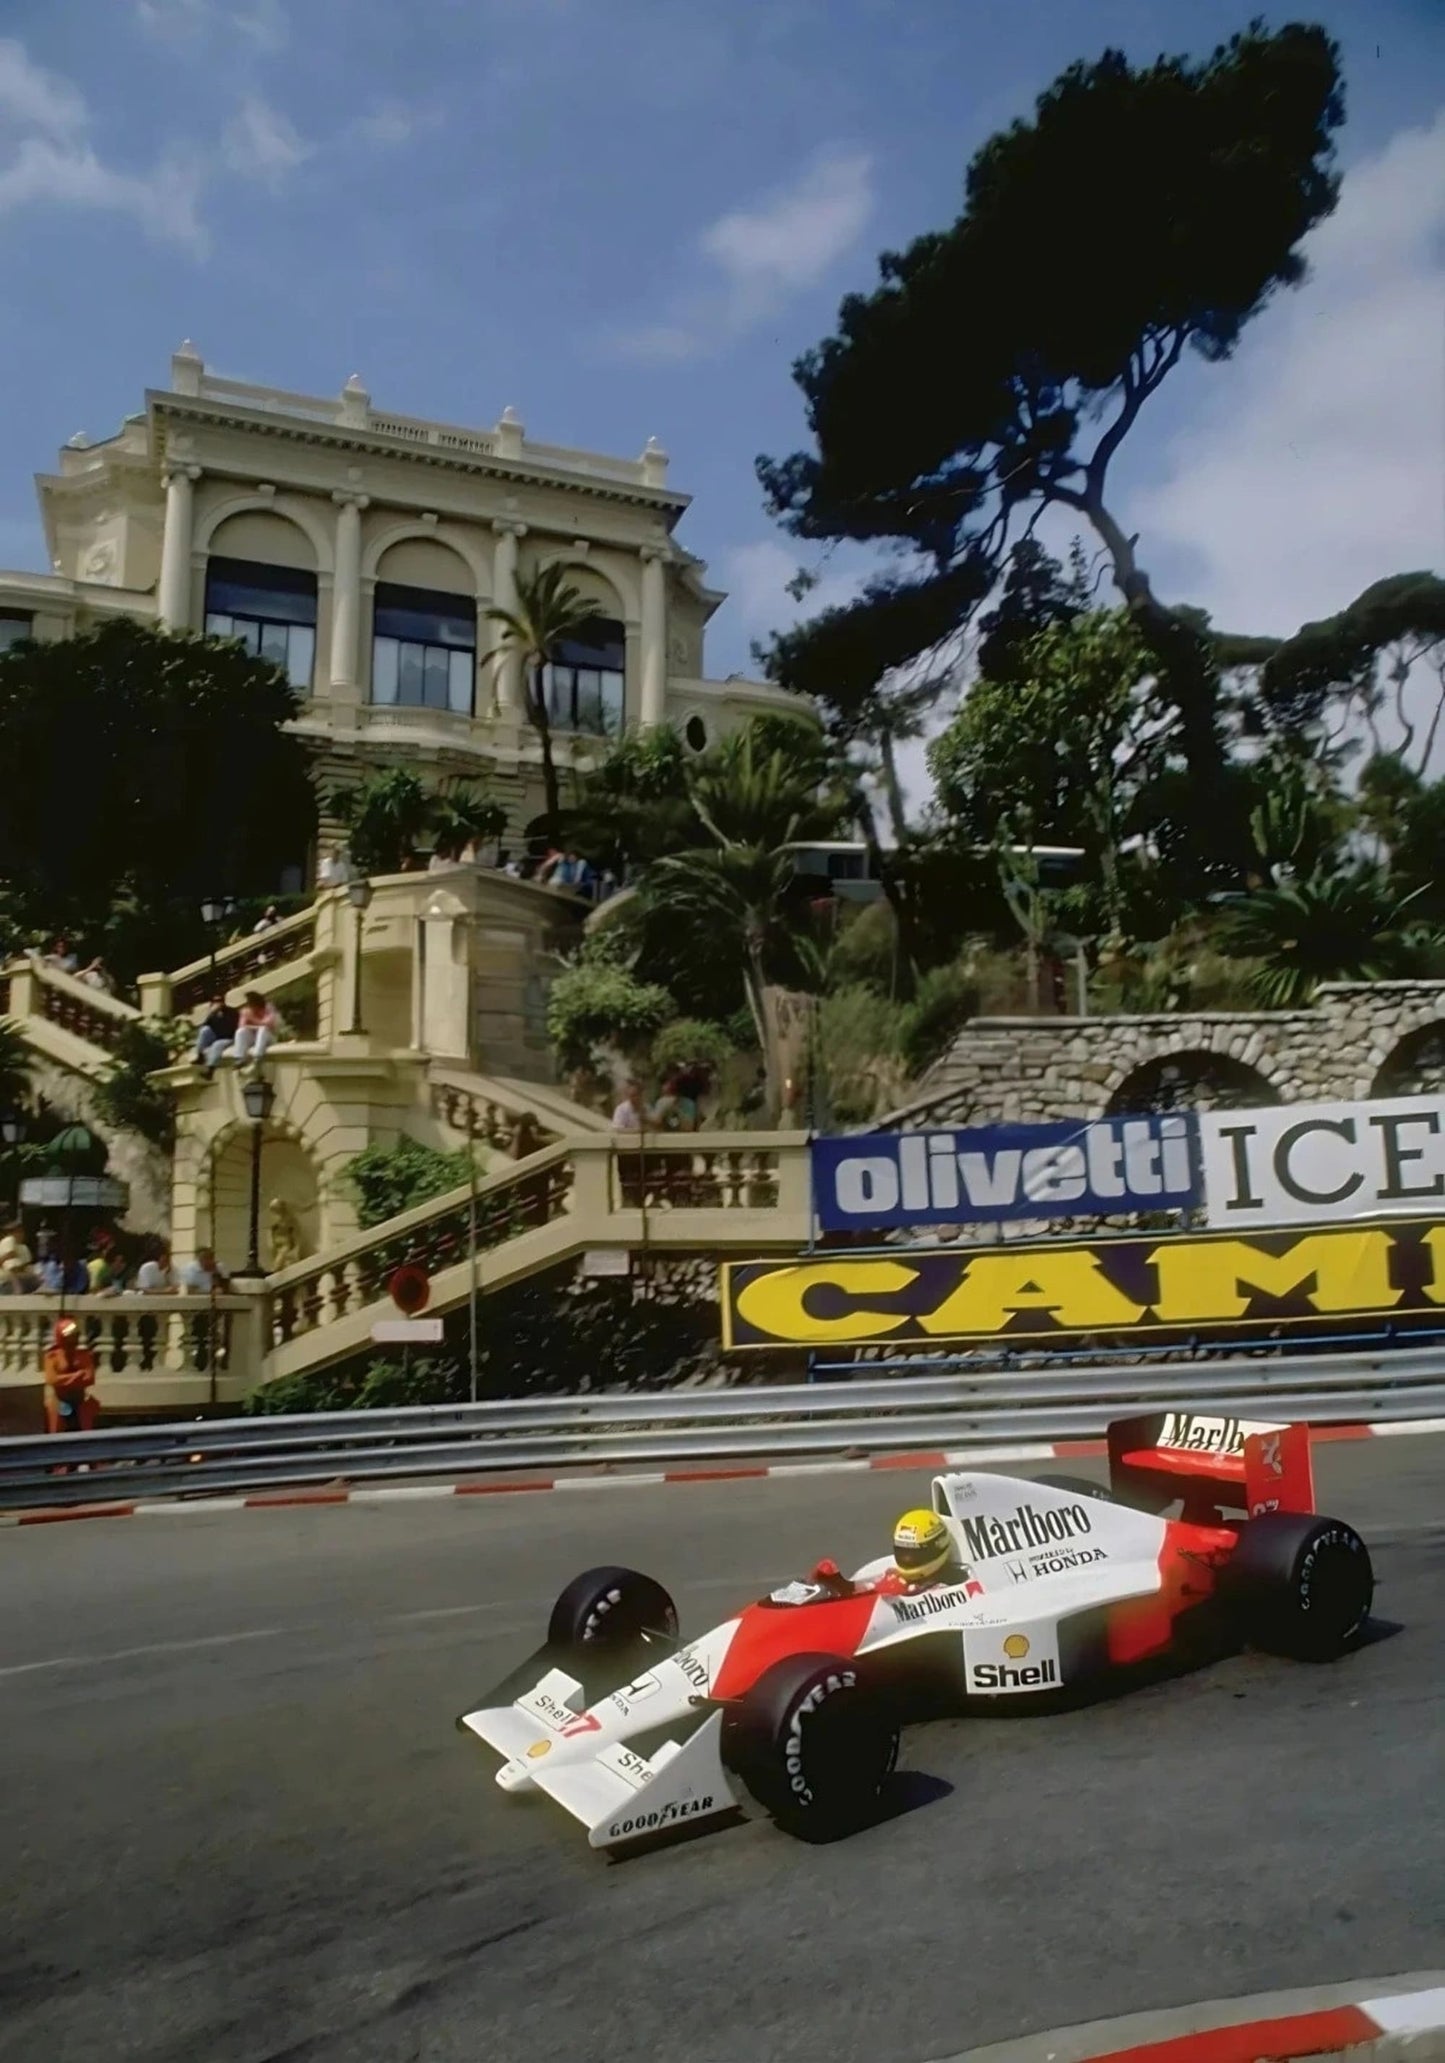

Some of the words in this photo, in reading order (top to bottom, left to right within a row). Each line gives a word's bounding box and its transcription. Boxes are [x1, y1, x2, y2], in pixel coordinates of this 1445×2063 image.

[835, 1117, 1192, 1213] olivetti
[1219, 1111, 1445, 1210] ICE
[736, 1226, 1445, 1342] CAM
[961, 1504, 1092, 1562] Marlboro
[1032, 1547, 1108, 1577] HONDA
[892, 1589, 967, 1623] Marlboro
[972, 1659, 1057, 1688] Shell
[609, 1796, 714, 1837] GOODYEAR
